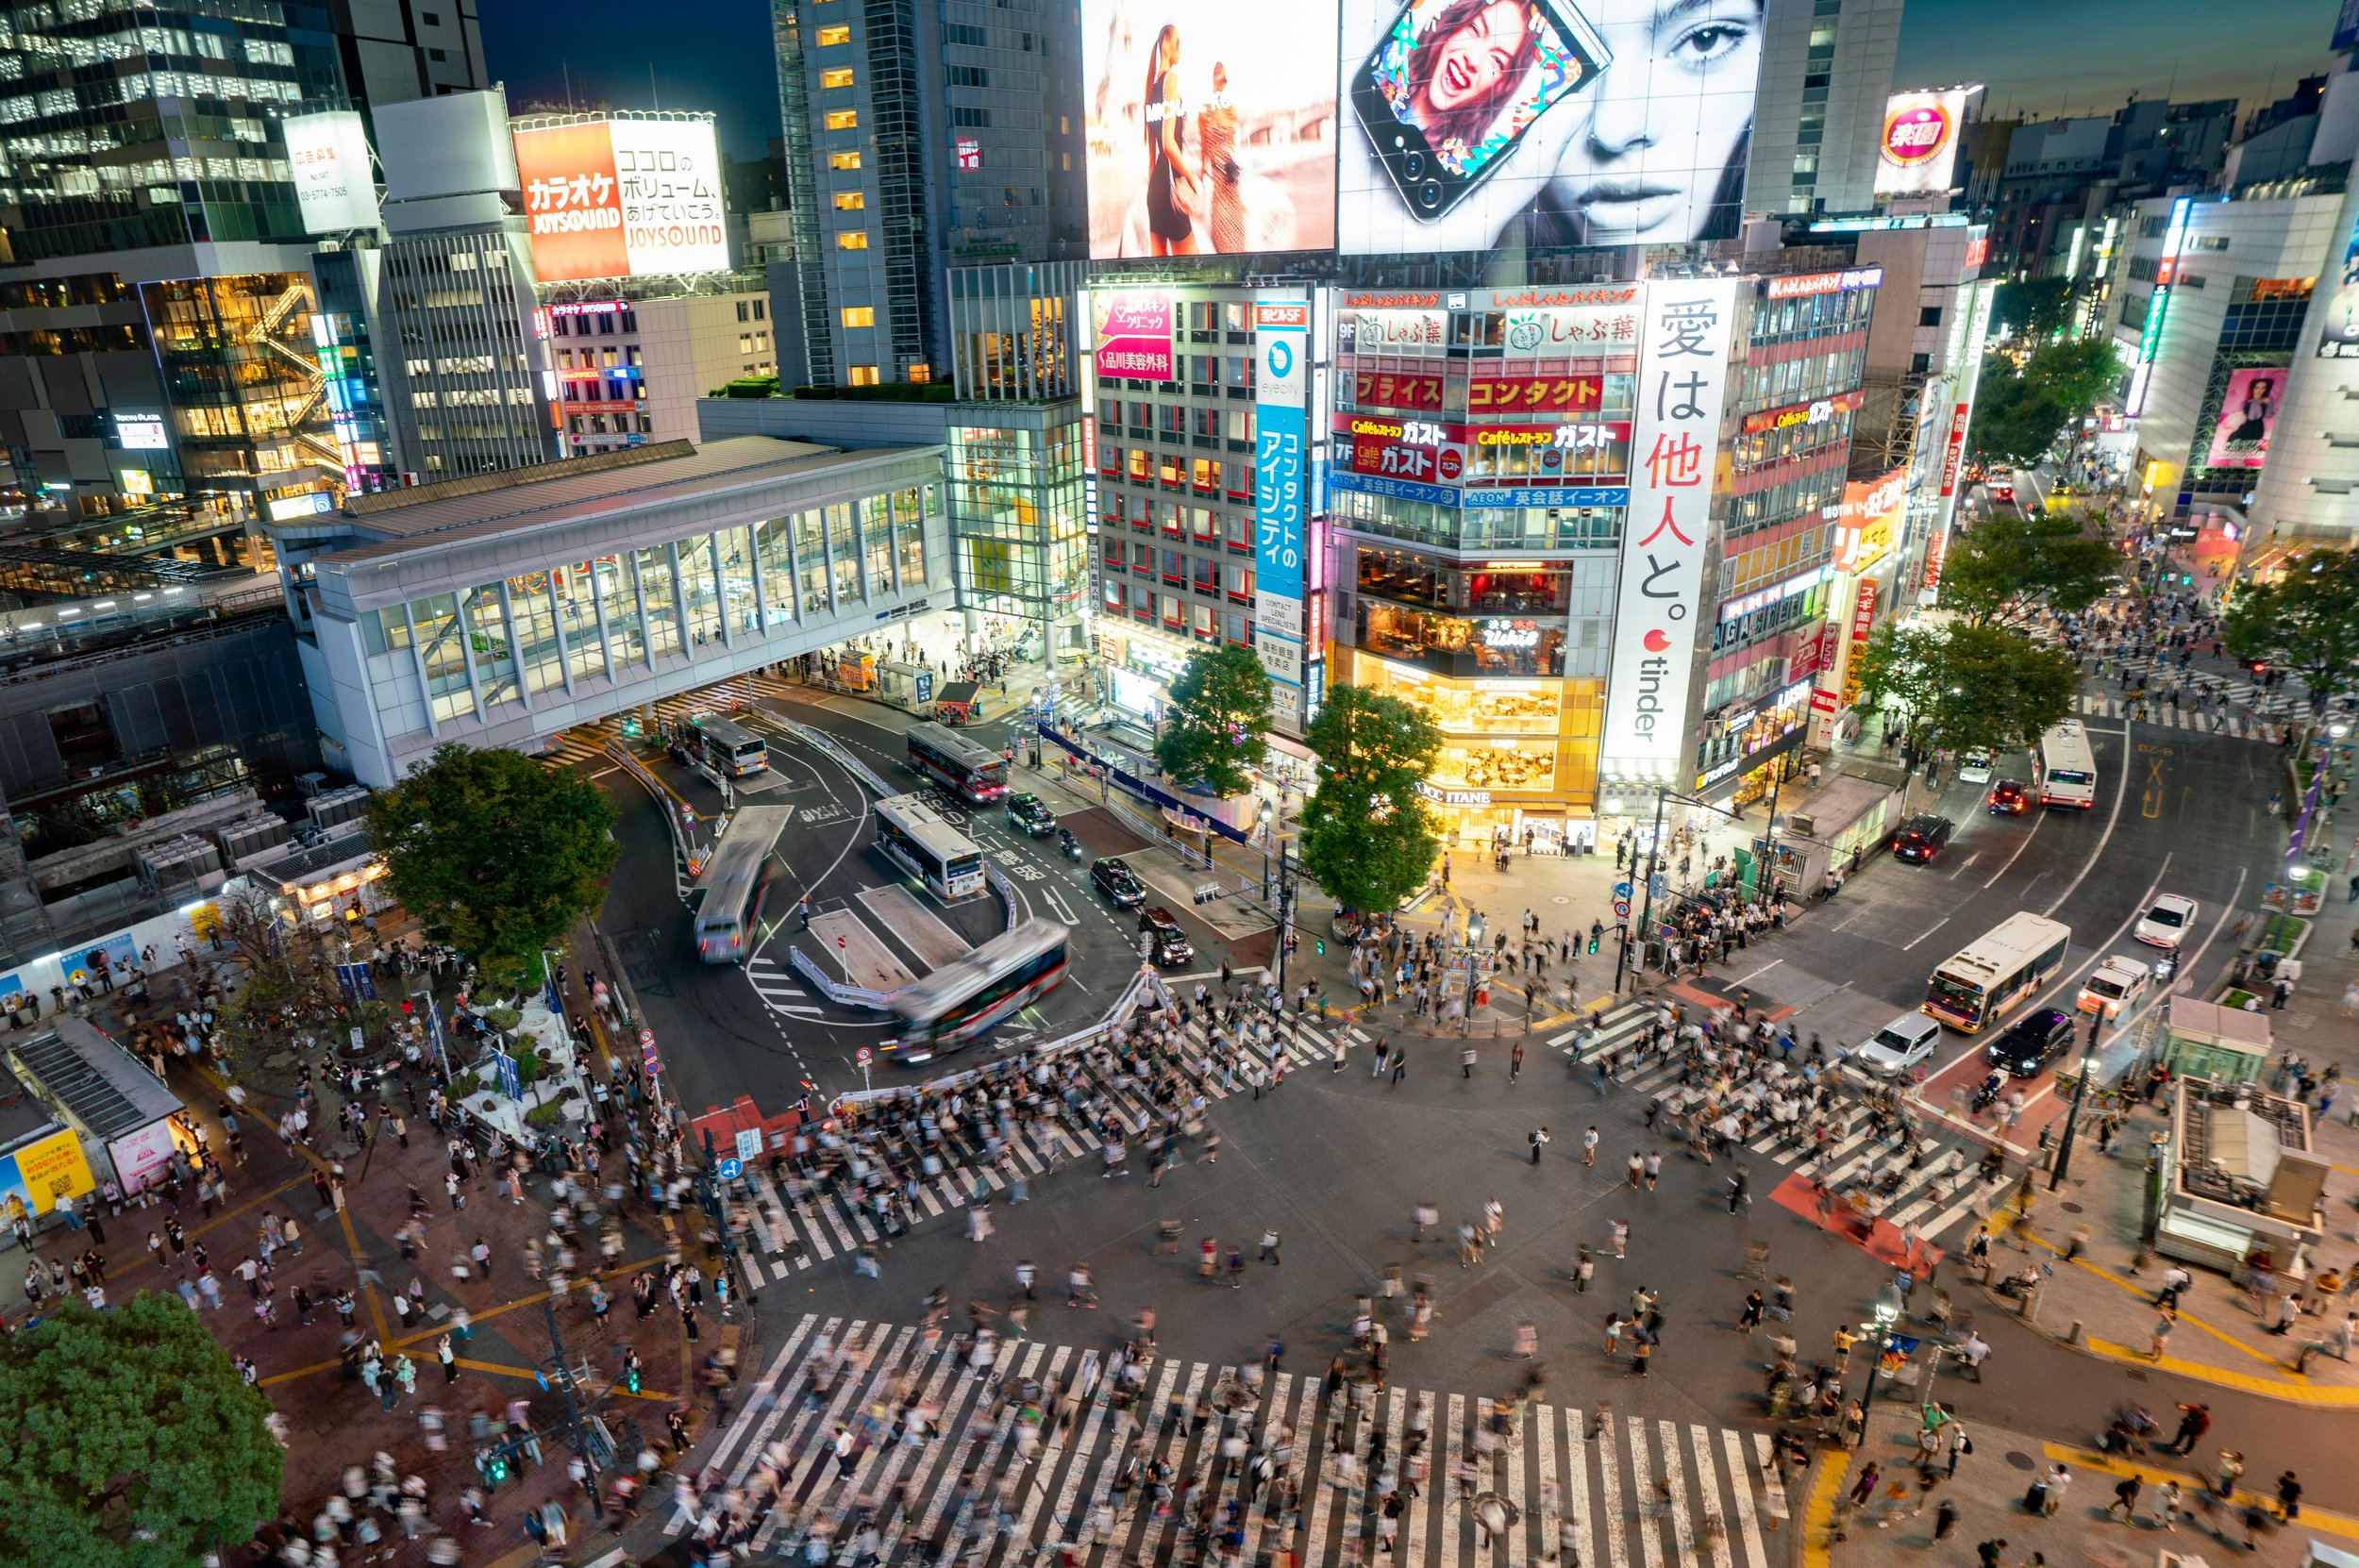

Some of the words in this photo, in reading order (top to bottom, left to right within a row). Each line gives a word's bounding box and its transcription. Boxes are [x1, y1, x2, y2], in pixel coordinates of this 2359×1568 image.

[1889, 121, 1943, 147] 楽園
[619, 150, 693, 172] ココロの
[527, 173, 614, 212] カラオケ
[623, 175, 717, 200] ボリューム、
[533, 208, 622, 235] JOYSOUND
[627, 203, 721, 222] あげていこう。
[628, 225, 722, 249] JOYSOUND
[552, 305, 580, 316] カラオケ
[1344, 292, 1441, 309] しゃぶしゃぶバイキング
[1494, 288, 1638, 309] しゃぶしゃぶバイキング
[1127, 315, 1163, 329] クリニック
[1260, 308, 1301, 323] 当ビル5F
[1551, 313, 1636, 342] しゃぶ葉
[1339, 324, 1355, 339] 9F
[1387, 319, 1442, 344] しゃぶ葉
[1106, 352, 1168, 373] 品川美容外科
[1261, 382, 1299, 399] eyecity
[1357, 375, 1442, 404] プライス
[1469, 379, 1599, 407] コンタクト
[1806, 400, 1834, 425] ガスト
[1402, 421, 1447, 446] ガスト
[1554, 425, 1616, 448] ガスト
[1335, 442, 1354, 460] 7F
[1358, 445, 1380, 459] Café
[1380, 445, 1433, 477] ガスト
[1645, 298, 1718, 623] 愛は他人と。
[1442, 461, 1461, 472] ガスト
[1943, 440, 1963, 488] TaxFree
[1334, 473, 1357, 487] AEON
[1364, 477, 1437, 500] 英会話イーオン
[1442, 491, 1454, 503] 6F
[1261, 430, 1281, 565] アイシティ
[1282, 432, 1298, 569] コンタクトの
[1470, 492, 1506, 504] AEON
[1515, 490, 1626, 506] 英会話イーオン
[1265, 599, 1292, 612] CONTACT
[1271, 609, 1286, 620] LENS
[1854, 586, 1875, 633] スギ薬局
[1261, 614, 1297, 631] SPECIALISTS
[1796, 642, 1817, 666] アコム
[1634, 656, 1668, 743] tinder
[1777, 679, 1810, 711] LUSH
[1843, 693, 1856, 702] 3F
[26, 1149, 76, 1175] 約100万名様に
